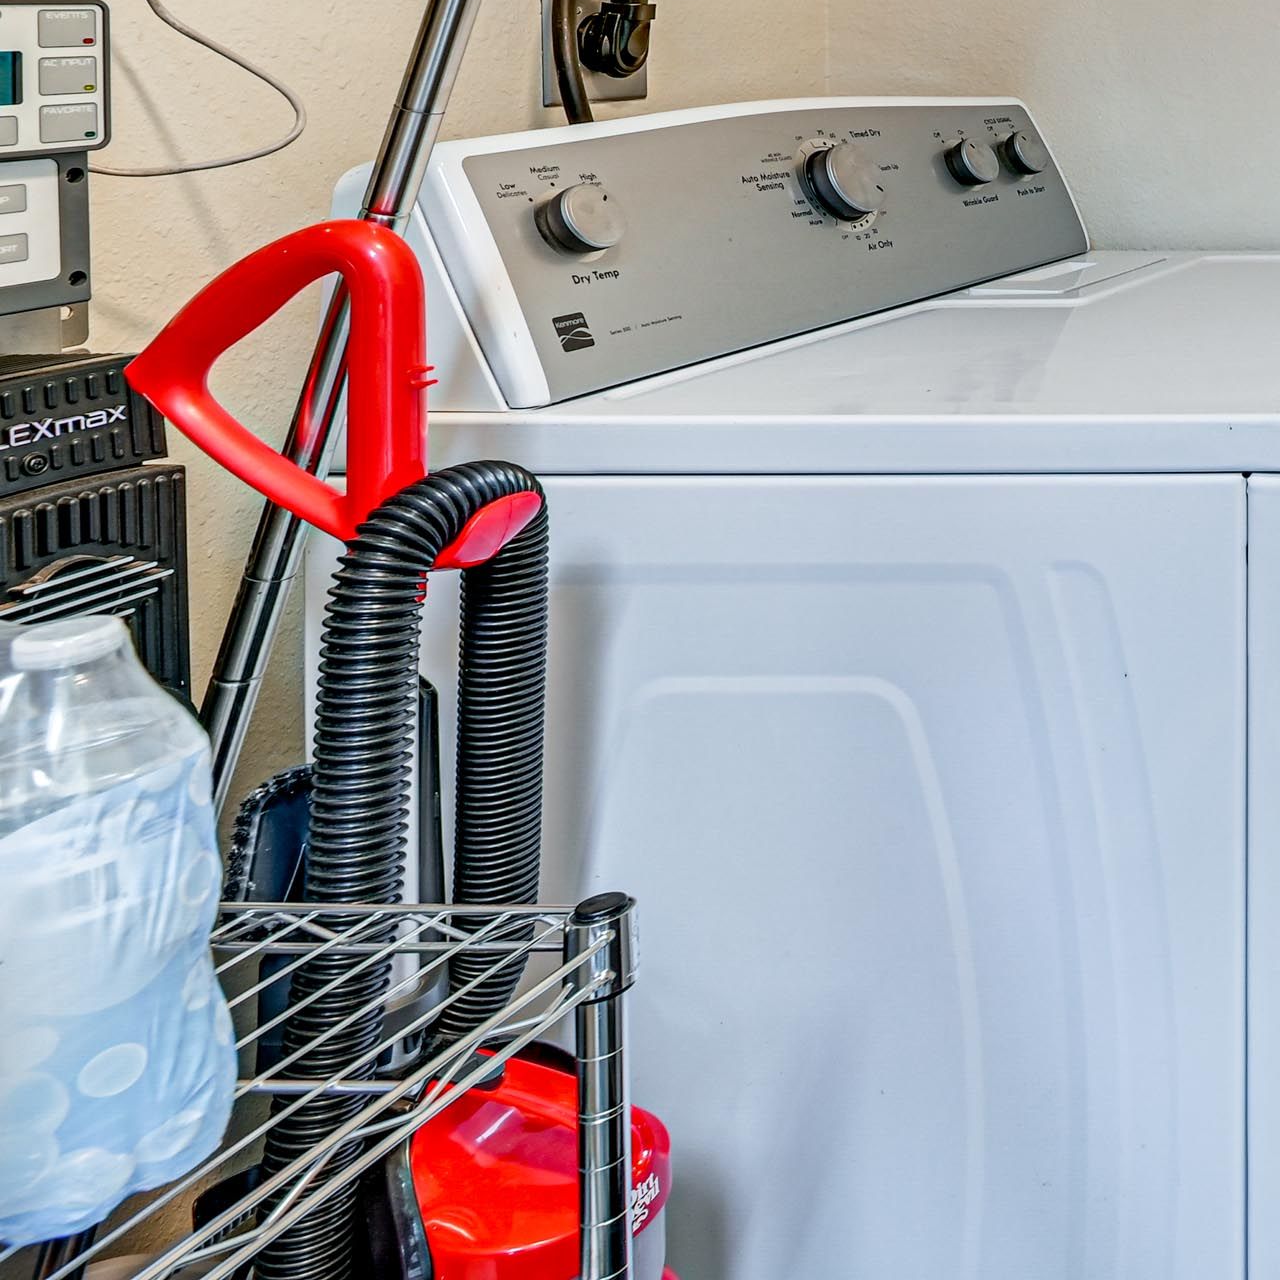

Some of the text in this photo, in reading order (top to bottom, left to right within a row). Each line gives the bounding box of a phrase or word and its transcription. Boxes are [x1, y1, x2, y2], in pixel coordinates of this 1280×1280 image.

[45, 11, 89, 21] EVENTS
[43, 105, 95, 115] FAVORITE
[850, 129, 881, 139] Timed Dry
[530, 165, 560, 174] Medium
[537, 173, 560, 181] Casual
[579, 172, 597, 182] High
[741, 171, 791, 184] Auto Moisture
[499, 183, 516, 191] Low
[756, 181, 785, 192] Sensing
[1016, 186, 1046, 197] Push Start
[962, 194, 999, 208] Wrinkle Guard
[791, 208, 814, 219] Normal
[808, 218, 823, 226] More
[868, 239, 894, 251] Air Only
[571, 269, 620, 285] Dry Temp
[554, 316, 585, 329] Kenmore
[0, 404, 127, 451] EXmax
